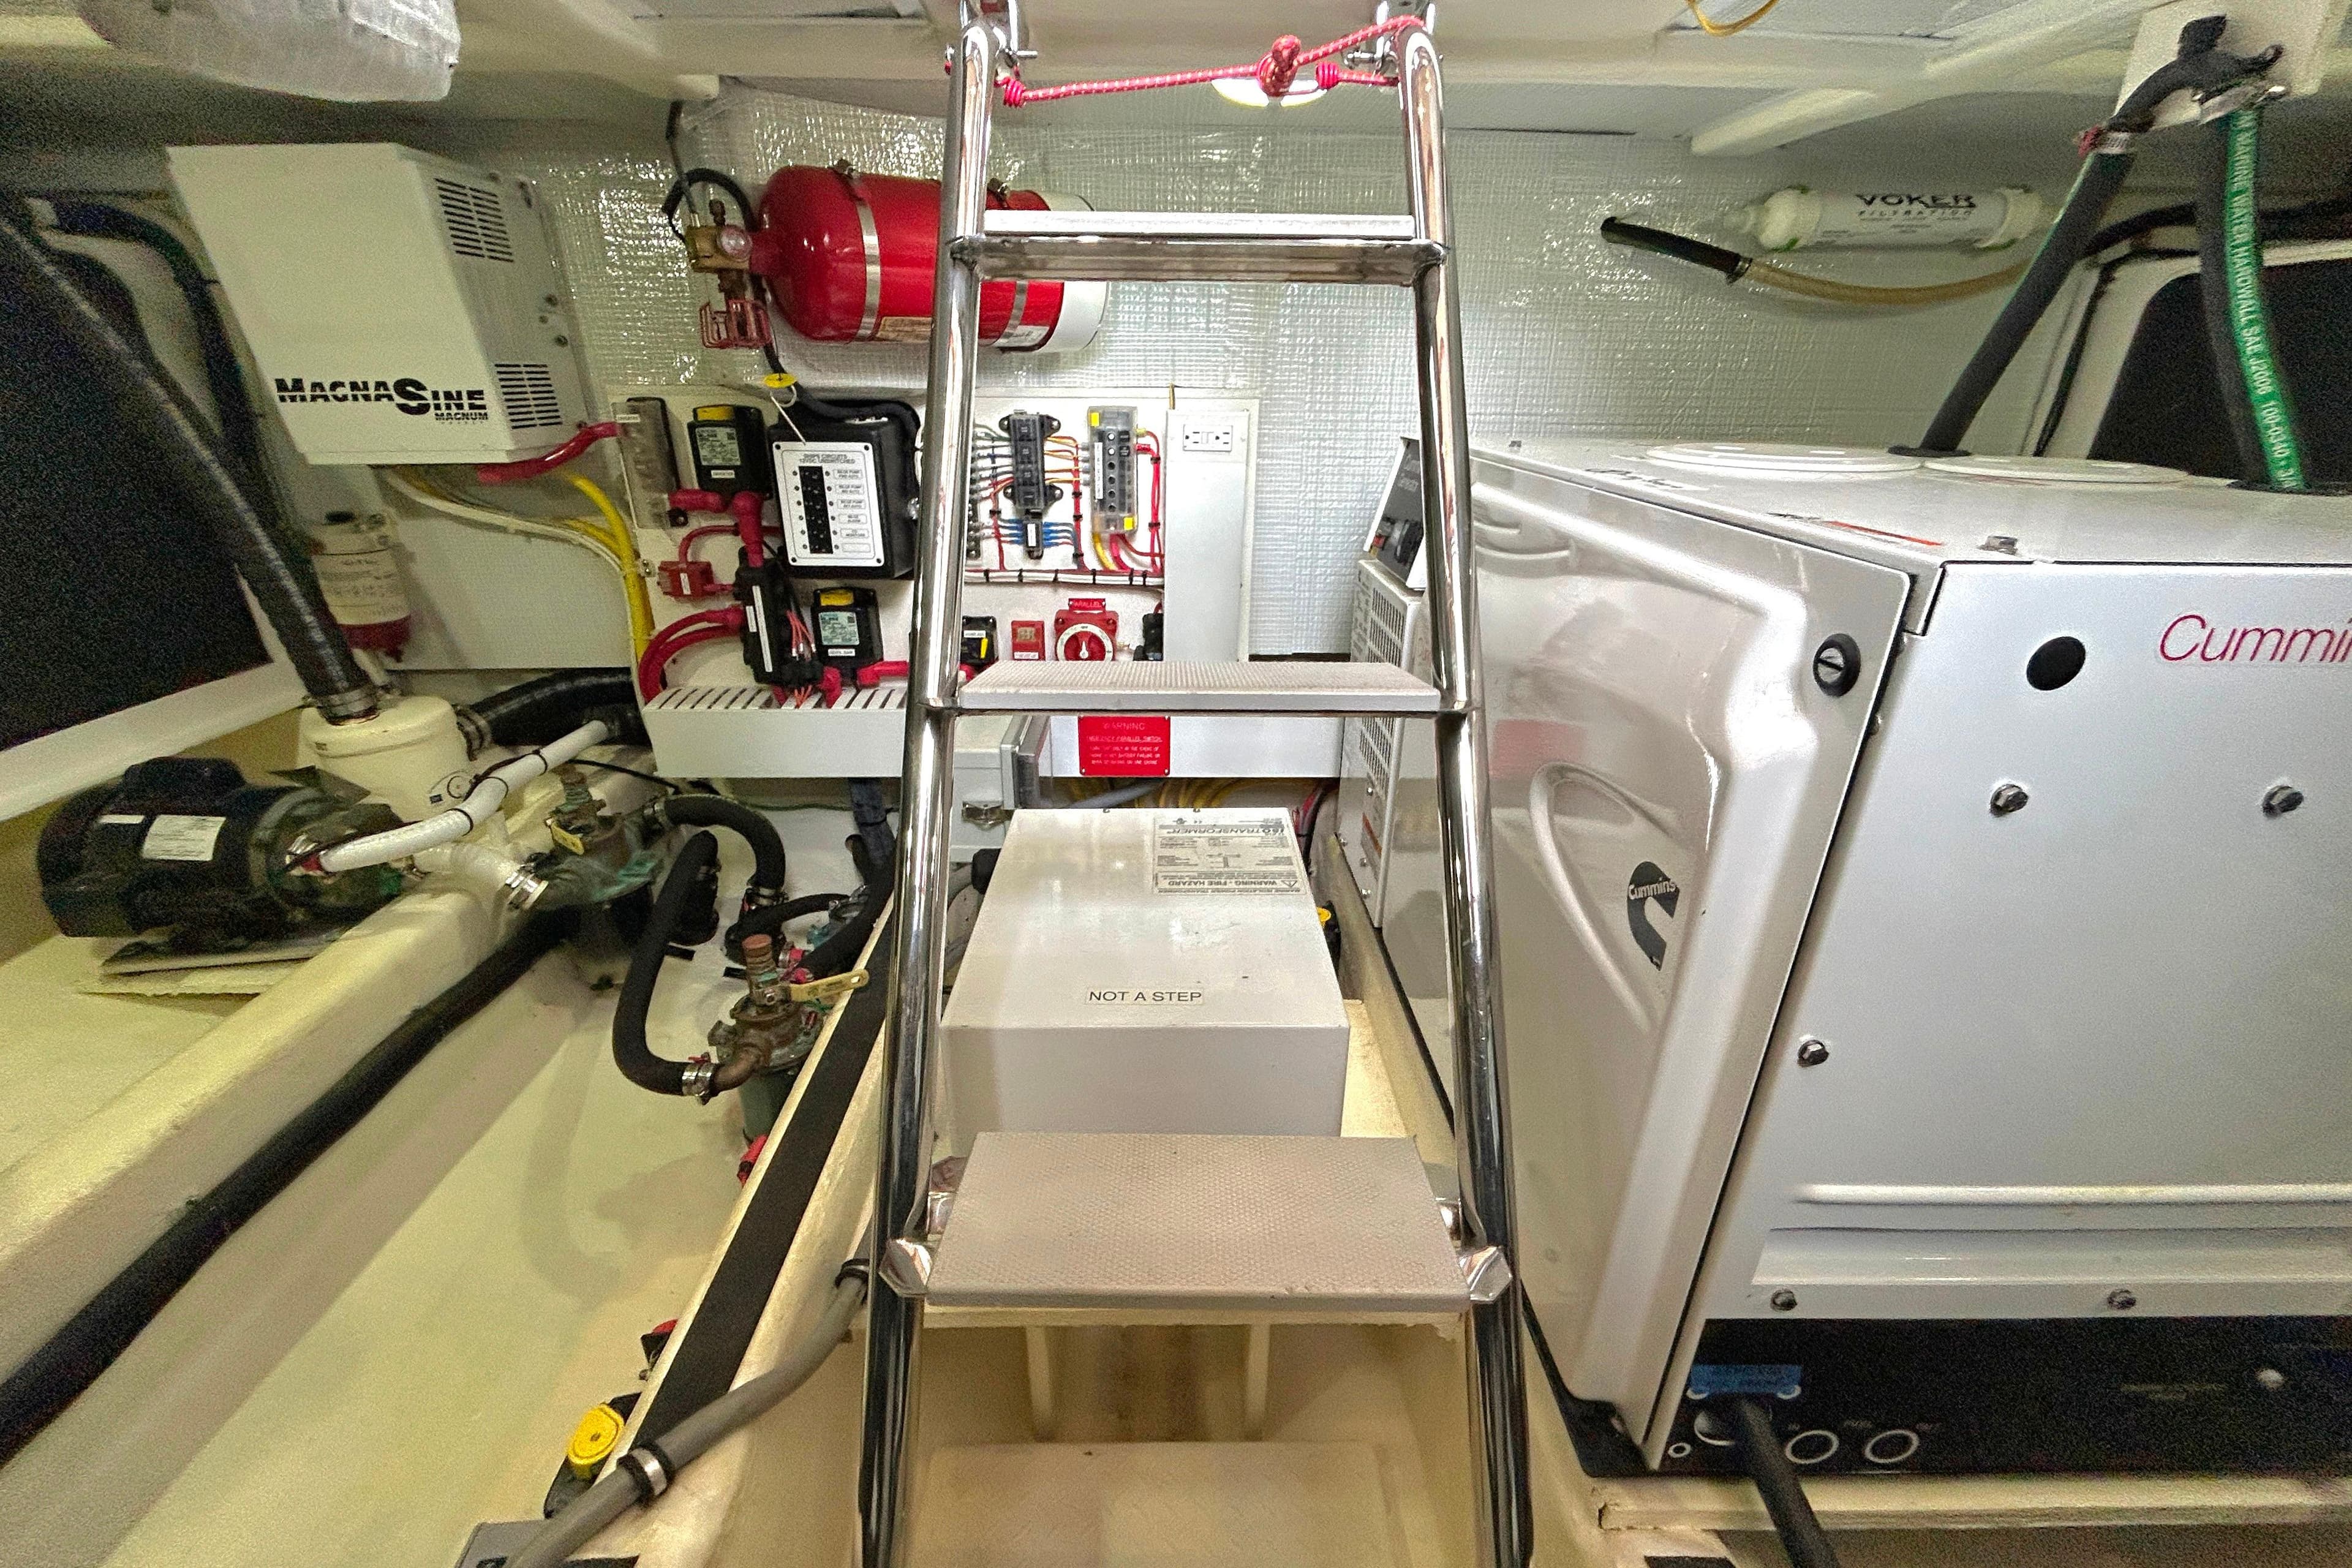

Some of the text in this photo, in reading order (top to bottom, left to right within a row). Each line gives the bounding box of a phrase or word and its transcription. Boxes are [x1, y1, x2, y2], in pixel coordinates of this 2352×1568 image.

[1856, 194, 1976, 208] VOKER
[2160, 614, 2352, 662] Cummi
[1628, 877, 1677, 900] Cummins
[1089, 991, 1202, 1002] NOT A STEP
